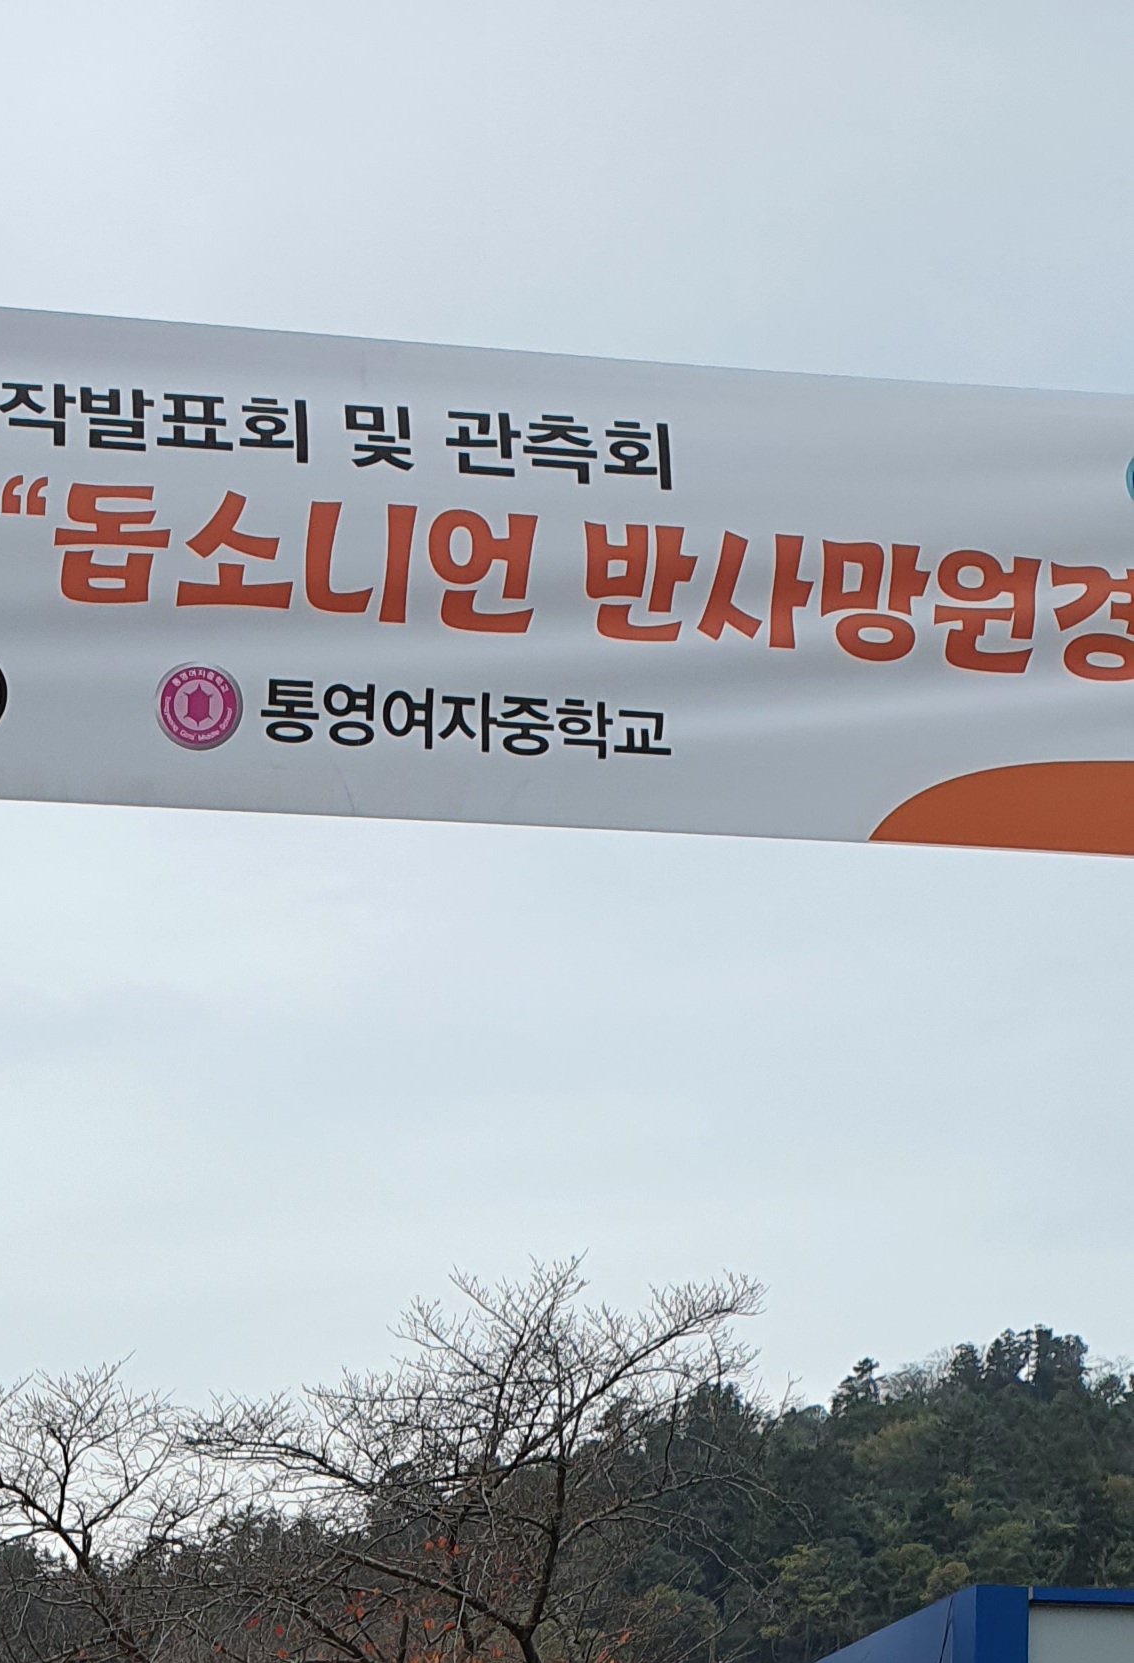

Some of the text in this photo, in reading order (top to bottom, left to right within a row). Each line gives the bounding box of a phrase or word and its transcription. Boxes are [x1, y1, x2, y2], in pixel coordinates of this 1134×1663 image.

[344, 404, 415, 472] 및
[445, 410, 673, 492] 관측회
[584, 522, 1134, 683] 반사망원경
[260, 678, 673, 761] 통영여자중학교
